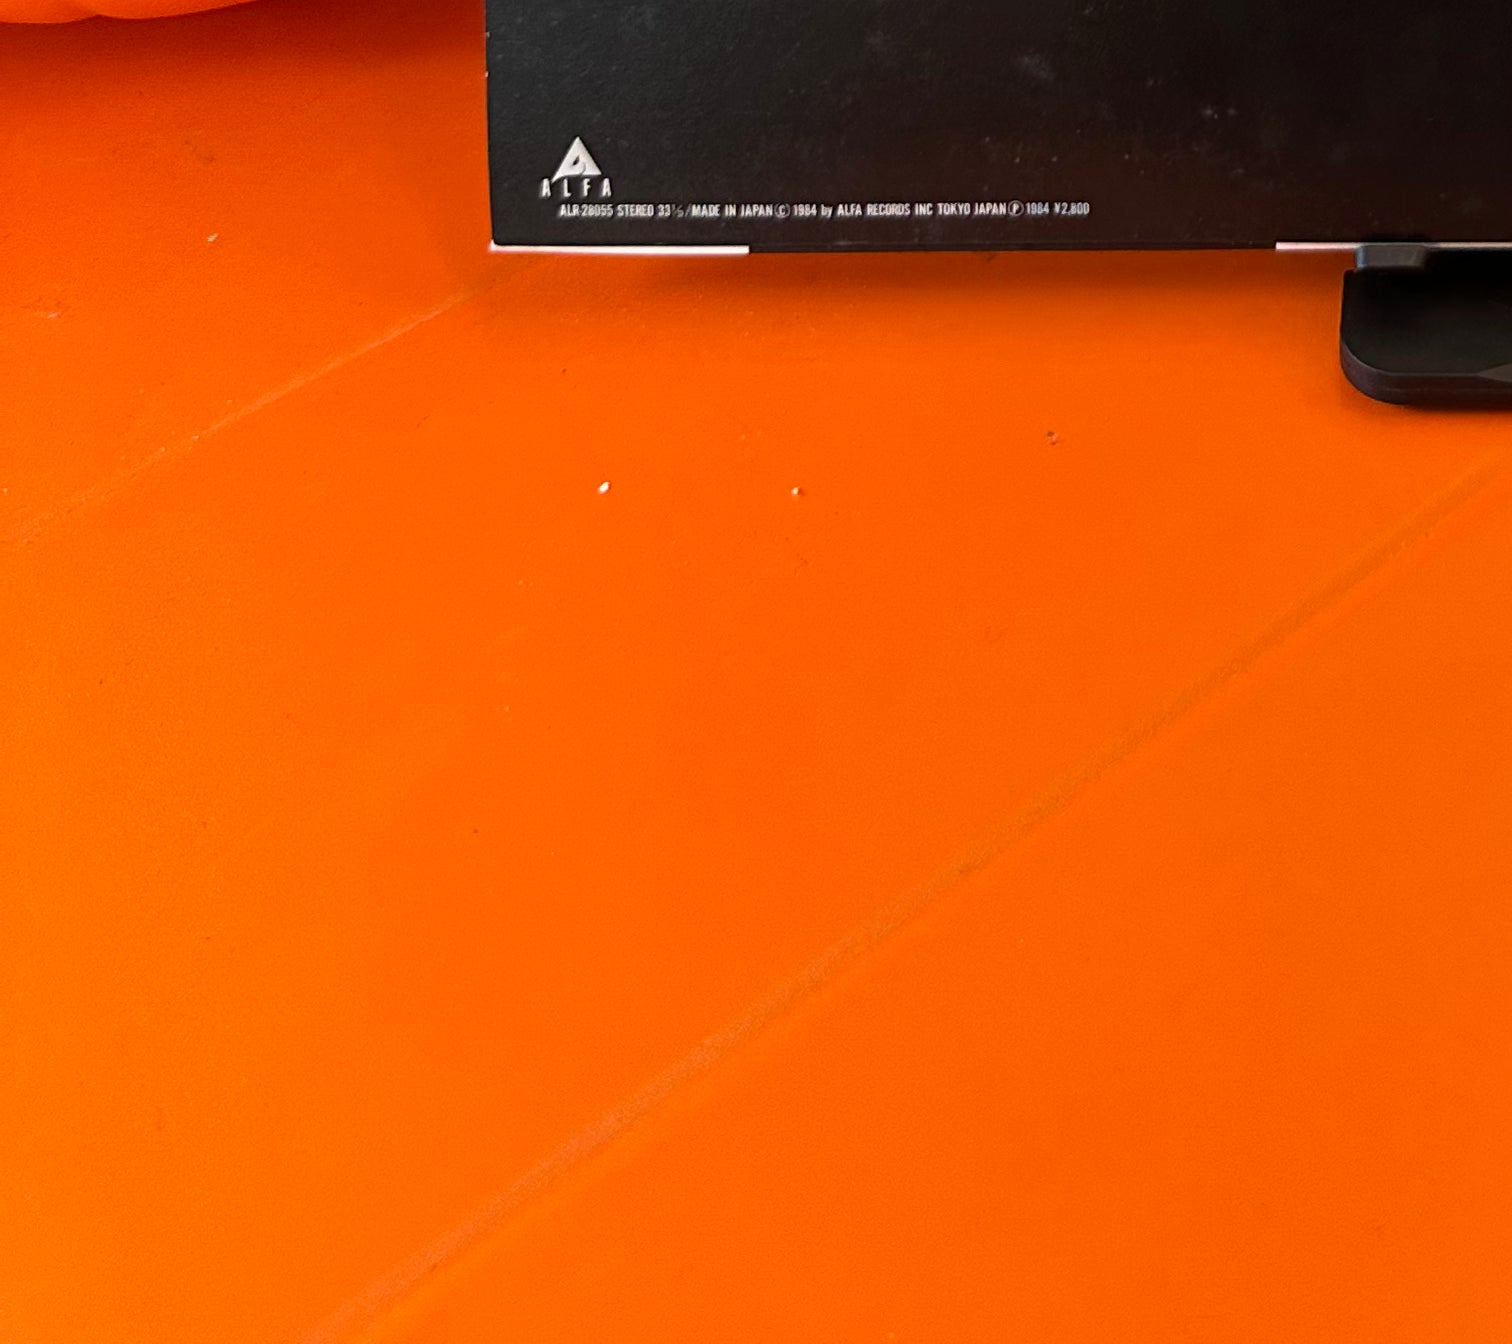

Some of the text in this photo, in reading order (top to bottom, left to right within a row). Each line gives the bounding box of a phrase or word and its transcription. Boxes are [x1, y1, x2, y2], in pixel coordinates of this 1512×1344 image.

[542, 179, 611, 197] ALFA
[617, 204, 654, 217] STEREO
[725, 204, 736, 217] IN
[821, 206, 833, 217] by
[837, 204, 862, 215] ALFA
[867, 203, 910, 215] RECORDS
[915, 203, 933, 215] INC
[937, 203, 971, 215] TOKYO
